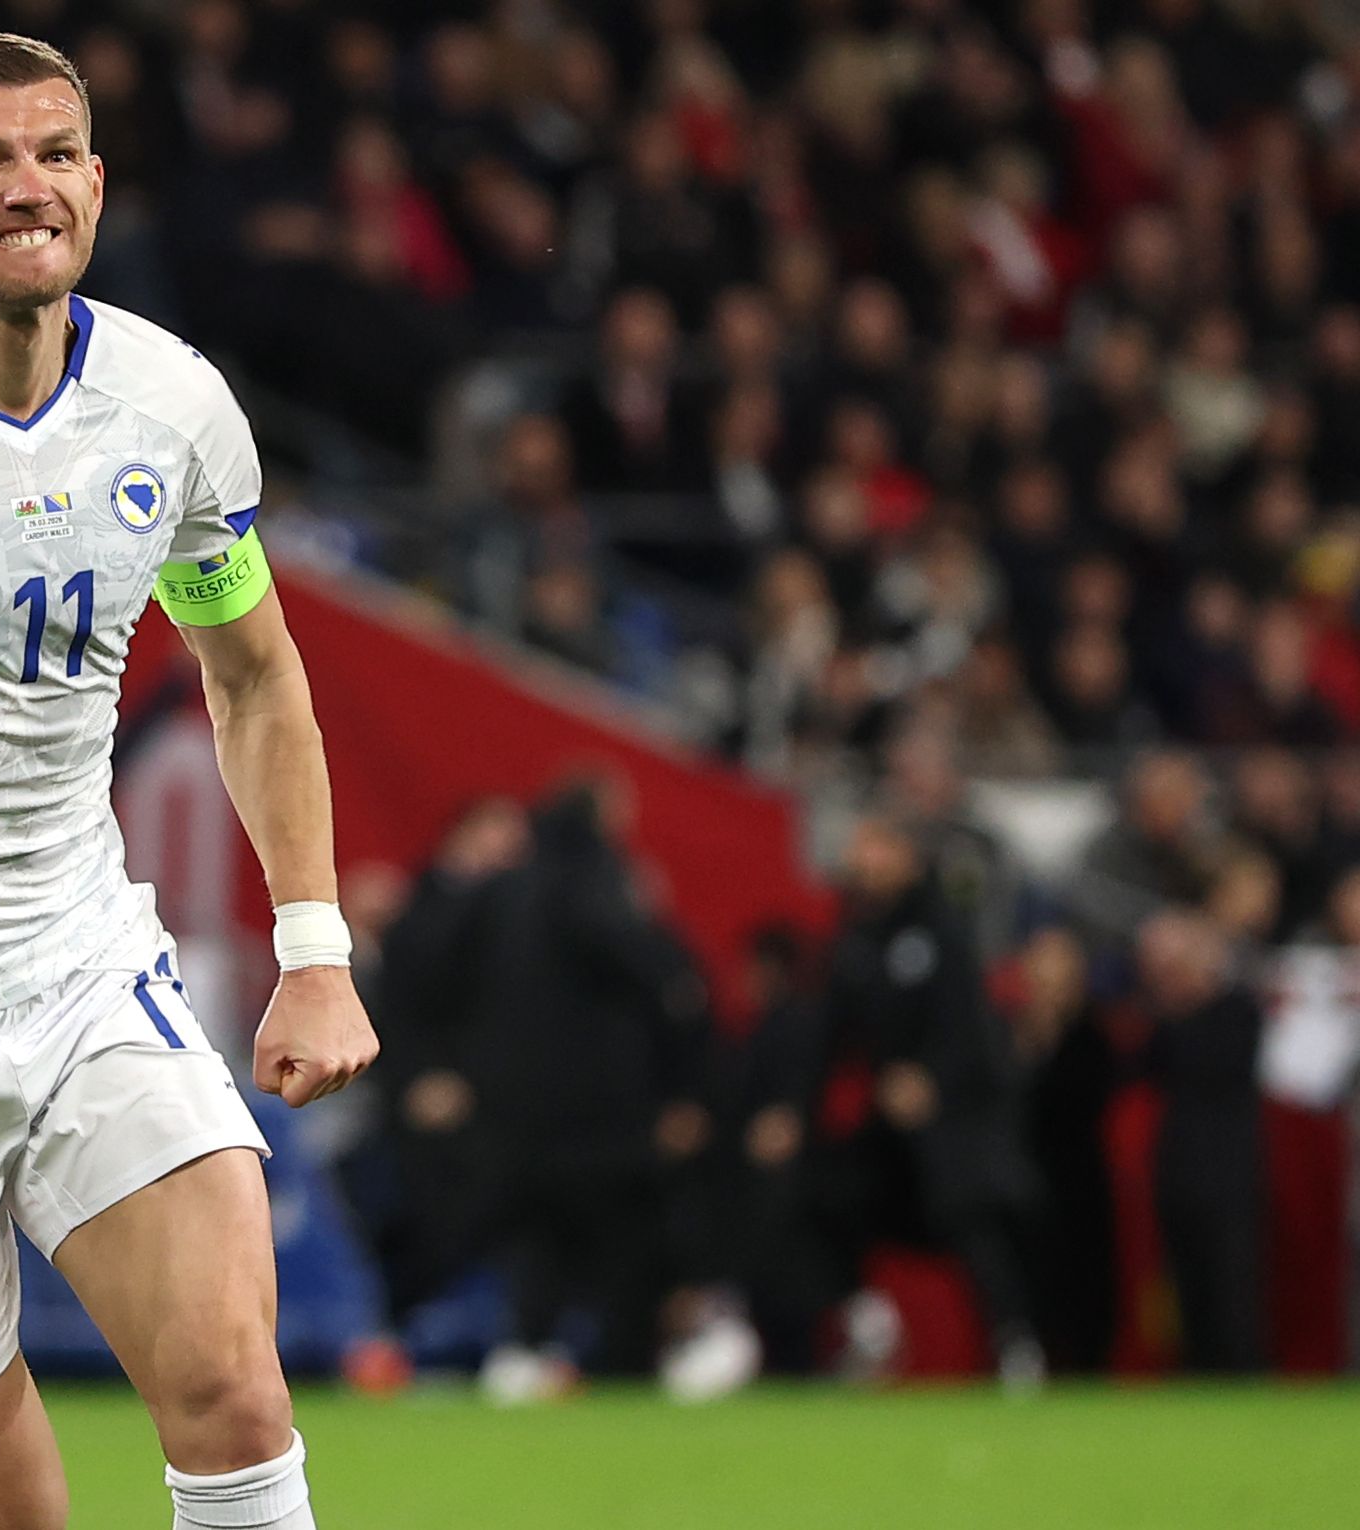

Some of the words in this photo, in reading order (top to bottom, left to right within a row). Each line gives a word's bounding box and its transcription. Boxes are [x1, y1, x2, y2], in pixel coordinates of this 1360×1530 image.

[25, 530, 48, 541] CARDIFF
[50, 527, 70, 537] WALES
[185, 557, 251, 599] RESPECT
[13, 569, 94, 684] 11
